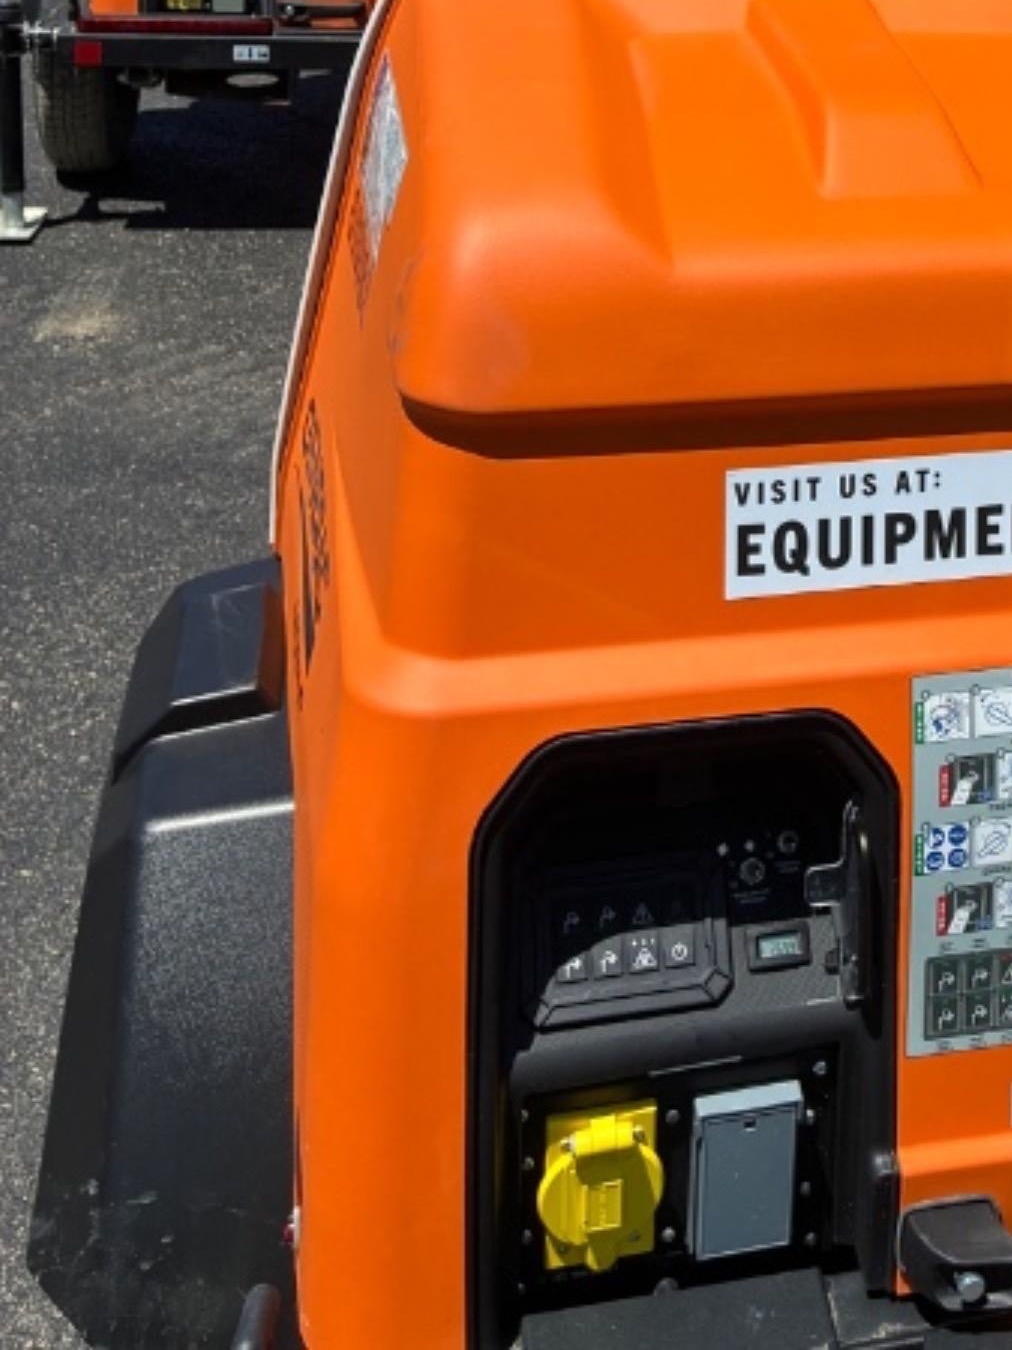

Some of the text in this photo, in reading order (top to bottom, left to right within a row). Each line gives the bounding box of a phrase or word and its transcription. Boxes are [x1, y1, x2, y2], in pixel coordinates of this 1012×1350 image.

[734, 469, 941, 507] VISIT US AT:
